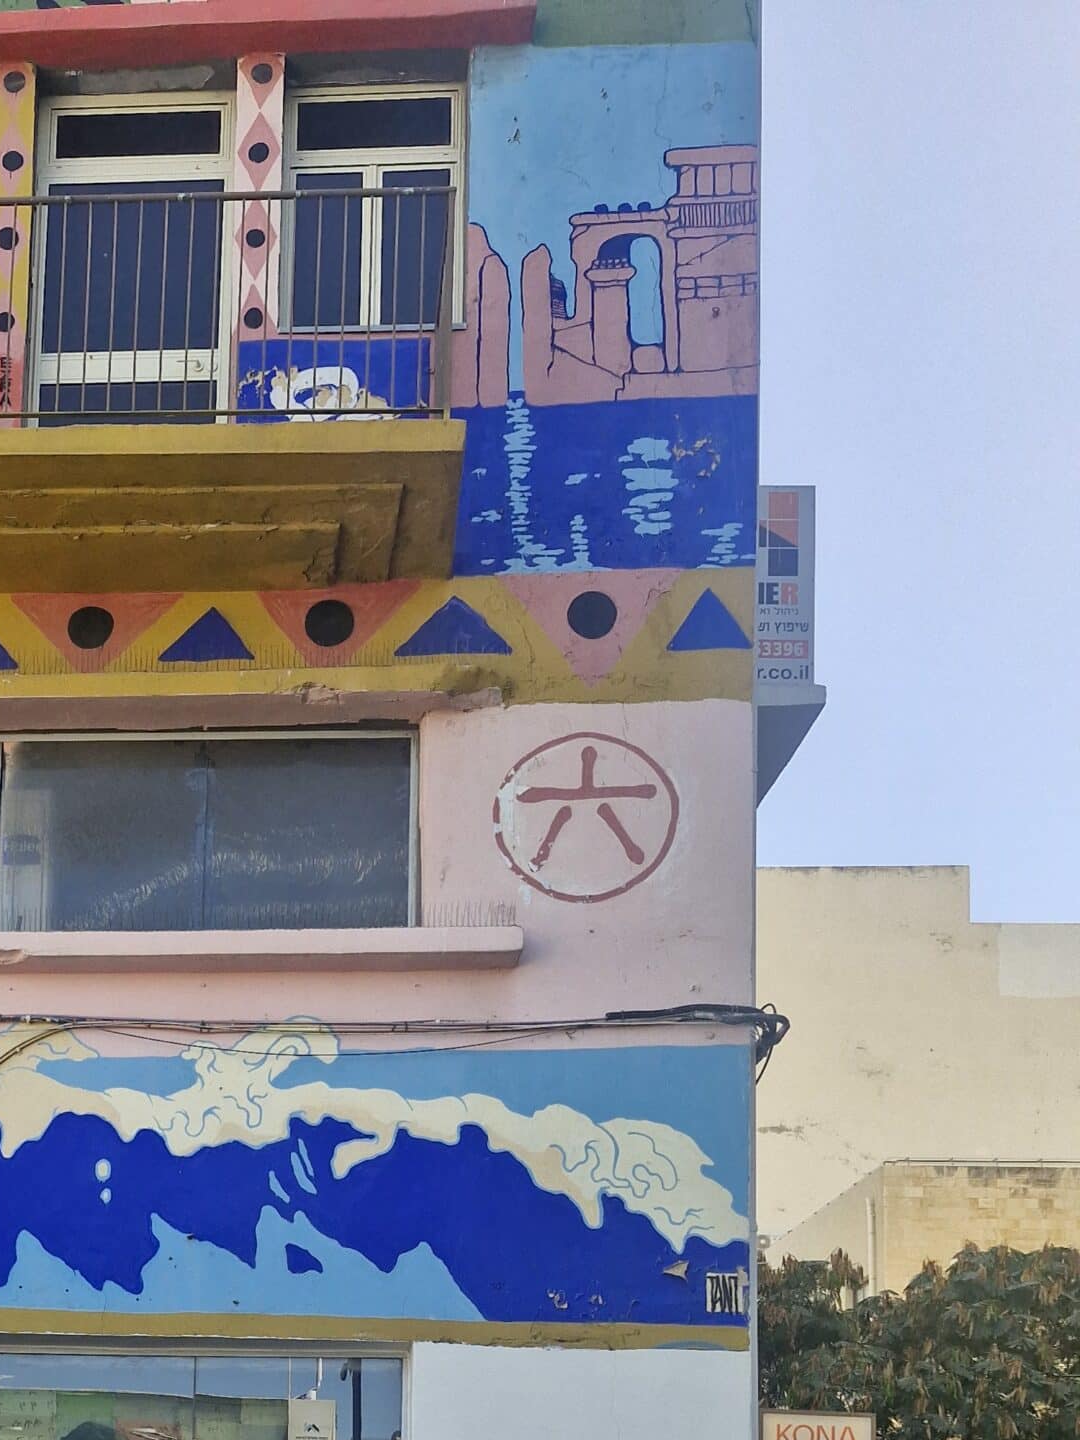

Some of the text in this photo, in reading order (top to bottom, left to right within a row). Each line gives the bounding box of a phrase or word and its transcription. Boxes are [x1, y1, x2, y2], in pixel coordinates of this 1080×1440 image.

[774, 621, 809, 634] שיפוץ
[758, 641, 804, 657] 3396
[516, 745, 658, 873] 六
